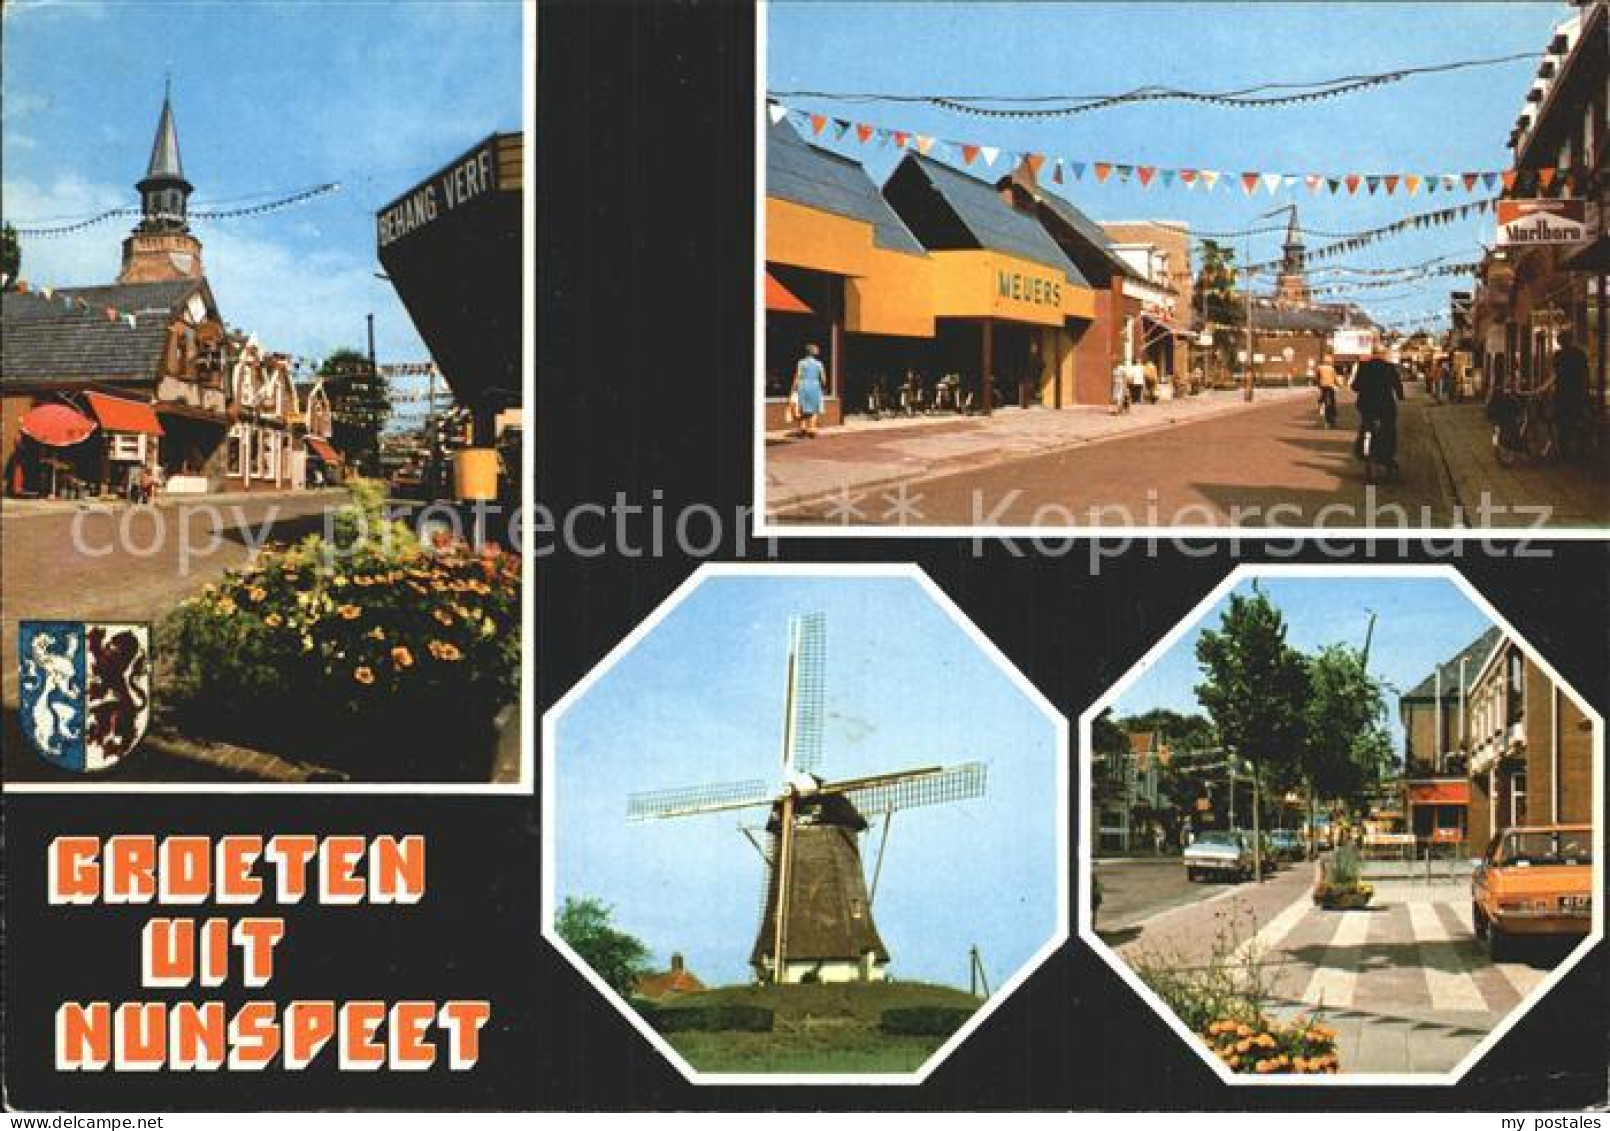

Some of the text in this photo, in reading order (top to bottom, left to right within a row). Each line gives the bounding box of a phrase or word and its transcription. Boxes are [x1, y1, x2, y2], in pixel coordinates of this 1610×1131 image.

[380, 149, 490, 247] BEHANG VERF
[1506, 219, 1581, 241] Marlboro
[48, 835, 425, 904] GROETEN
[142, 918, 284, 987] UIT
[55, 1001, 491, 1071] NUNSPEET
